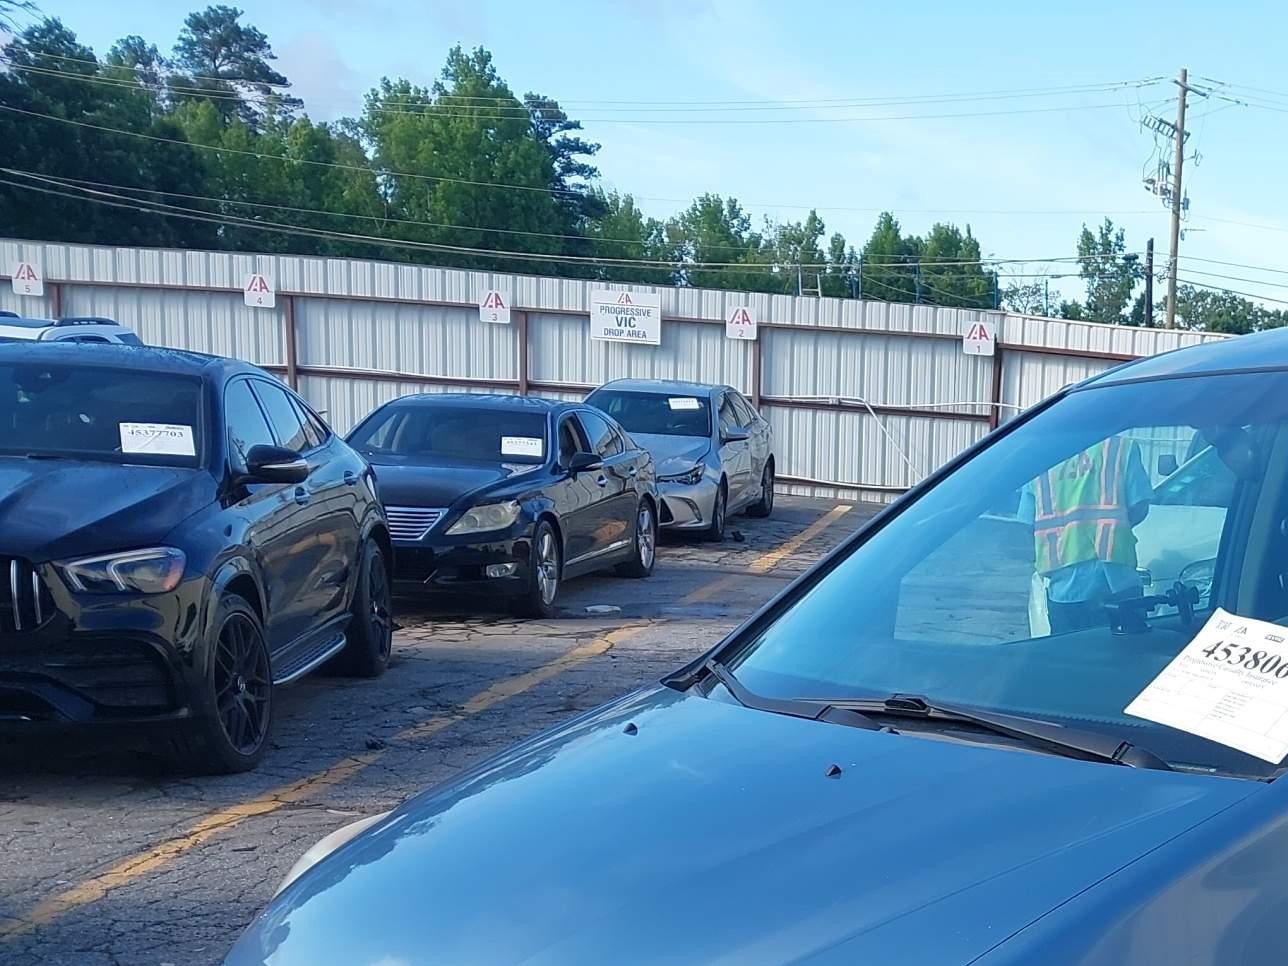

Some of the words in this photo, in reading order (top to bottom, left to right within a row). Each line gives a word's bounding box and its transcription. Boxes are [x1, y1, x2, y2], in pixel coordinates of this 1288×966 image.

[24, 284, 31, 293] 5
[600, 305, 652, 317] PROGRESSIVE
[615, 316, 637, 329] VIC
[603, 327, 624, 338] DROP
[626, 329, 647, 339] AREA
